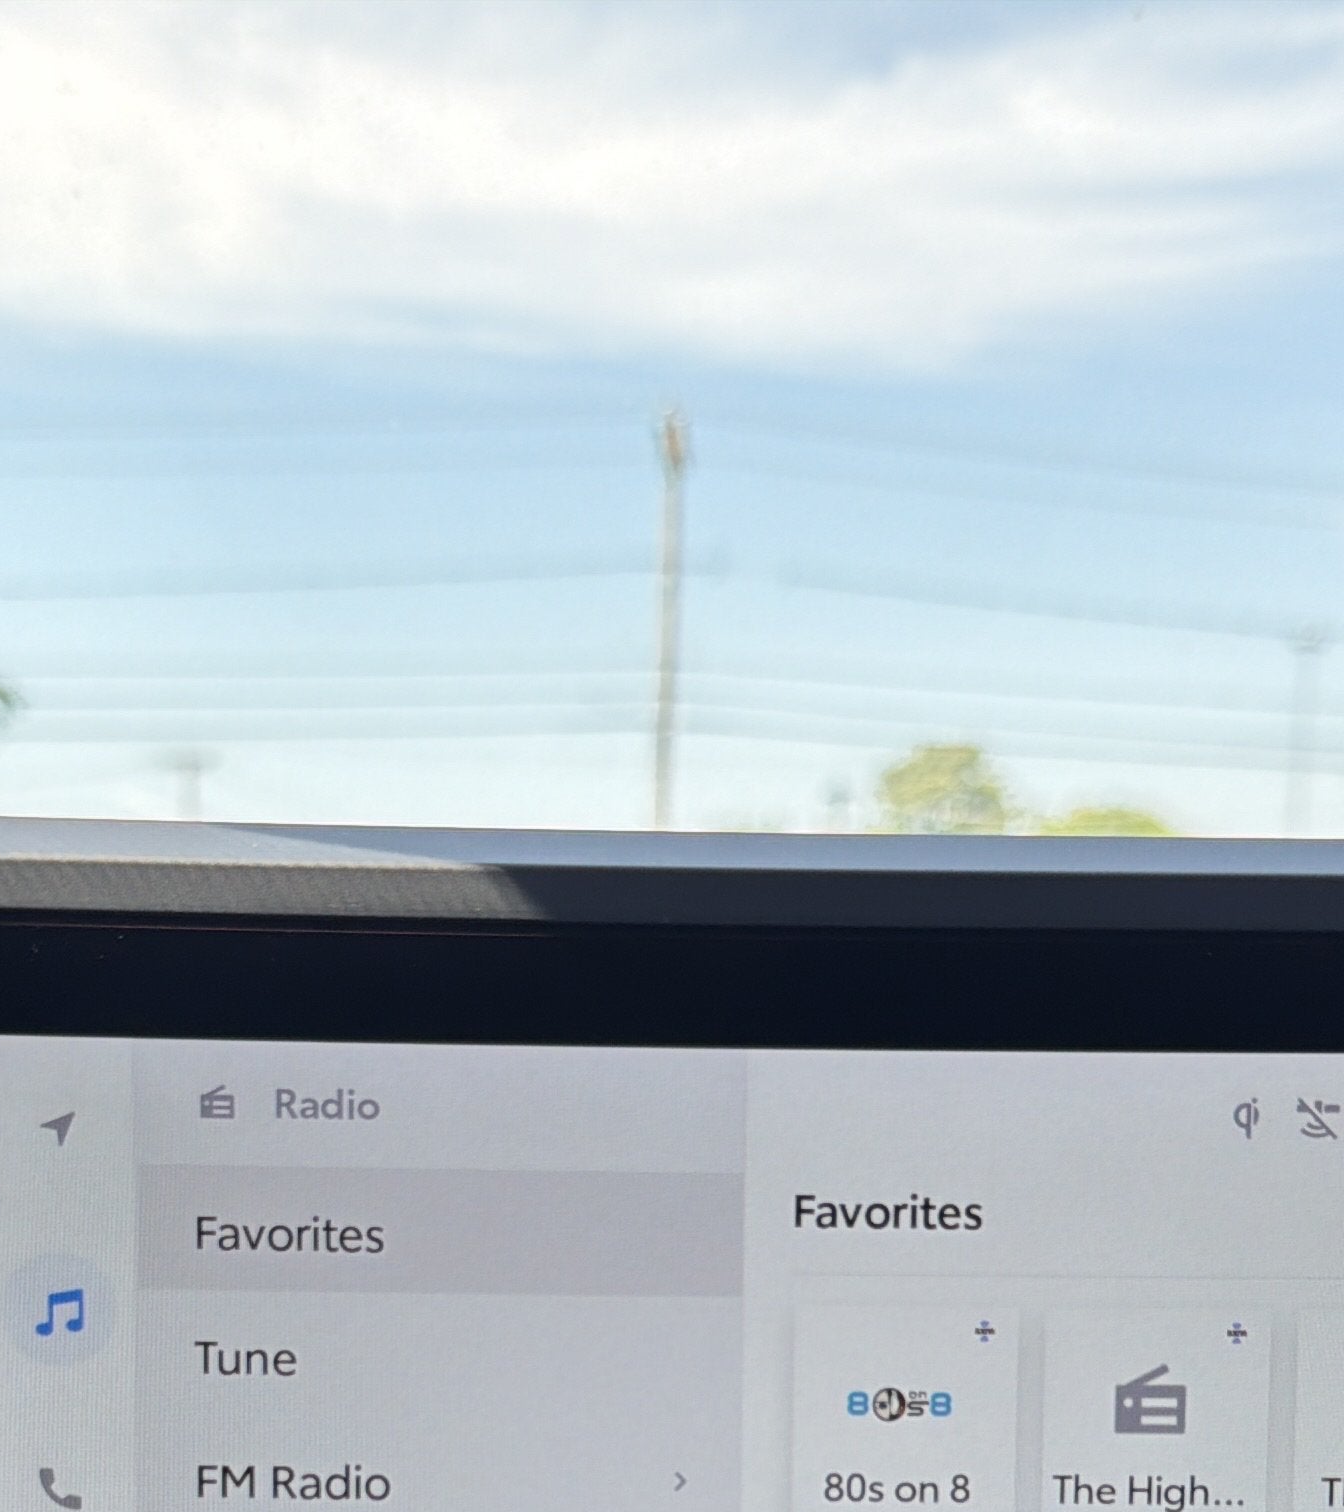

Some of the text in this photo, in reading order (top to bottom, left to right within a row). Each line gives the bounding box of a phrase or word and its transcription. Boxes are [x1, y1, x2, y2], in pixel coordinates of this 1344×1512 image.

[274, 1088, 381, 1122] Radio
[793, 1194, 983, 1231] Favorites
[195, 1214, 385, 1256] Favorites
[195, 1340, 298, 1378] Tune
[196, 1462, 391, 1502] FM Radio
[823, 1472, 971, 1504] 80s on 8
[1052, 1473, 1117, 1505] The
